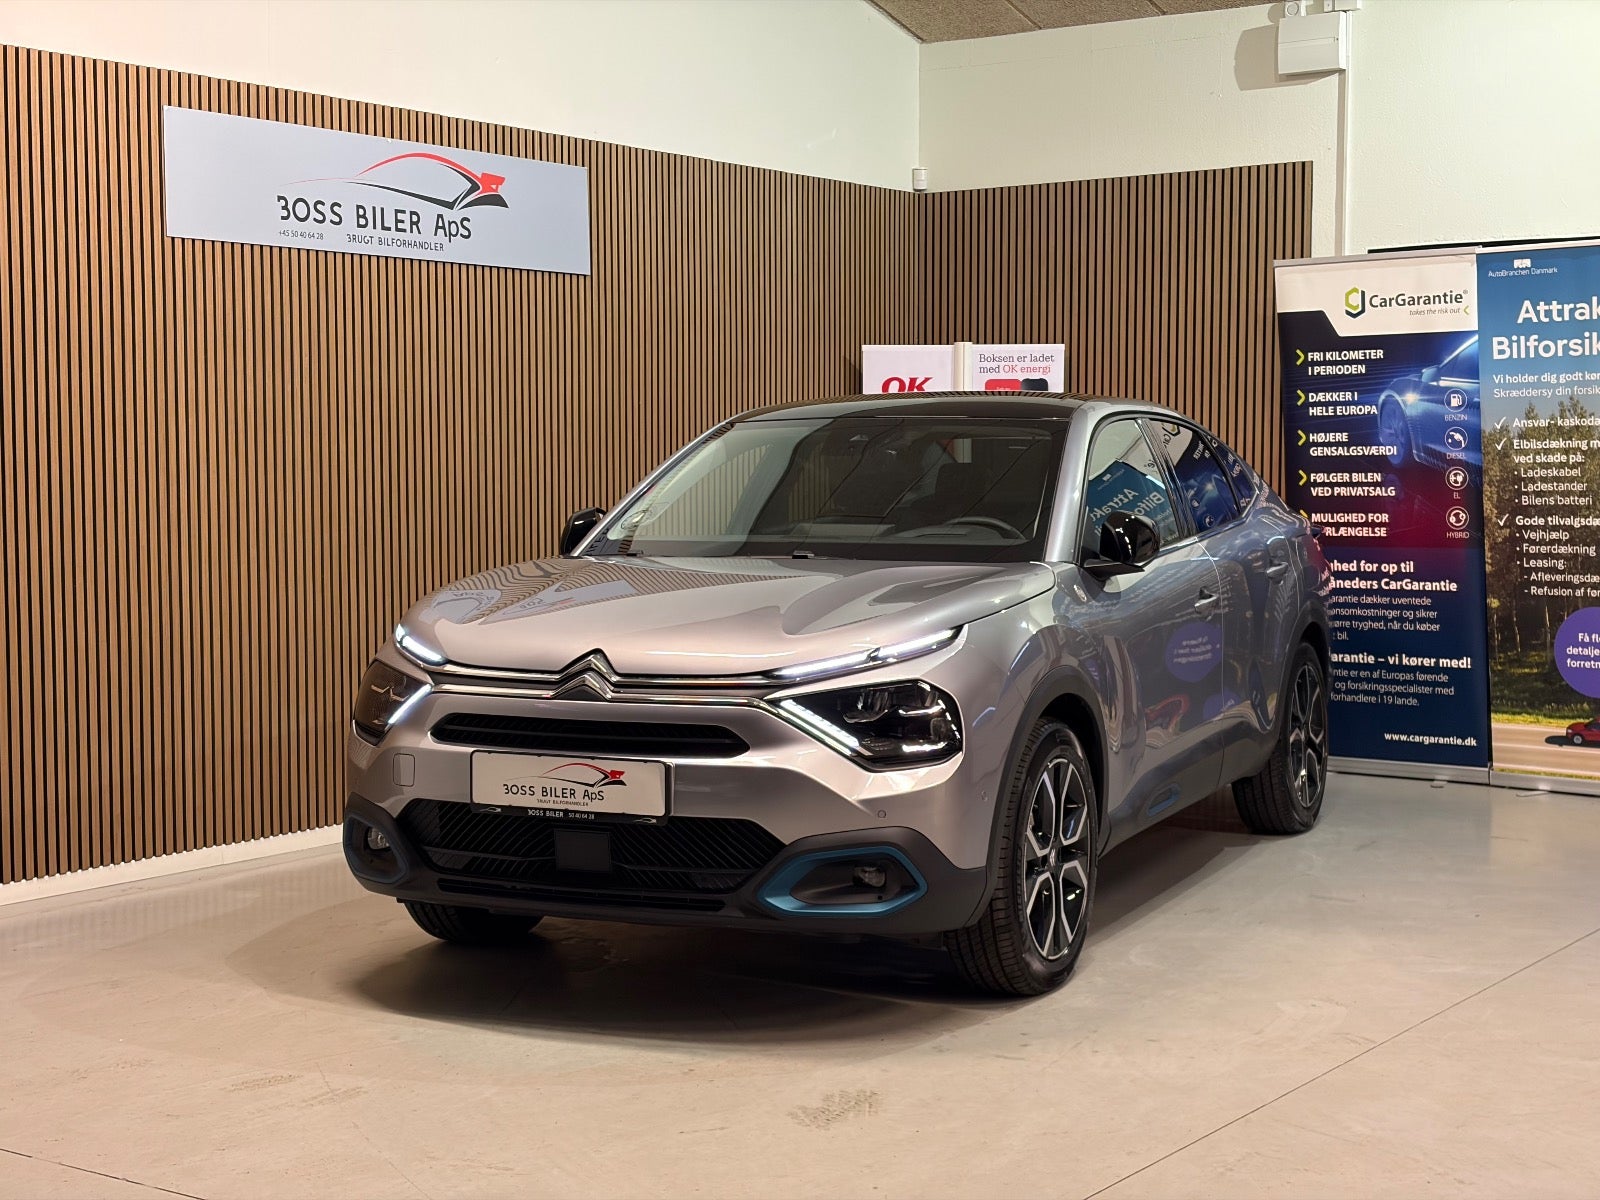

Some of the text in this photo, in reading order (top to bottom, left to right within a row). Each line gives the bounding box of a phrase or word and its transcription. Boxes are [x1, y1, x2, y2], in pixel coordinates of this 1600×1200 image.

[356, 204, 422, 234] BILER
[434, 213, 472, 243] ApS
[279, 229, 324, 240] +45 50 40 64 28
[378, 237, 444, 252] BILFORHANDLER
[1488, 266, 1558, 278] AutoBranchen Danmark
[1409, 308, 1425, 316] takes
[1426, 307, 1436, 315] the
[1437, 307, 1449, 315] risk
[979, 353, 1055, 363] Boksen er ladet
[1308, 349, 1384, 362] FRI KILOMETER
[979, 365, 1051, 376] med OK energi
[1308, 364, 1366, 375] I PERIODEN
[1493, 374, 1504, 384] Vi
[1505, 374, 1539, 384] holder
[1541, 372, 1557, 383] dig
[1559, 371, 1583, 384] godt
[882, 376, 933, 393] OK
[1309, 392, 1358, 402] DÆKKER I
[1494, 387, 1553, 399] Skræddersy
[1555, 386, 1571, 396] din
[1309, 405, 1378, 416] HELE EUROPA
[1444, 414, 1468, 422] BENZIN
[1512, 417, 1555, 428] Ansvar-
[1309, 432, 1349, 443] HØJERE
[1513, 439, 1588, 451] Elbilsdækning
[1310, 445, 1397, 457] GENSALGSVÆRDI
[1513, 453, 1585, 465] ved skade på:
[1310, 472, 1381, 484] FØLGER BILEN
[1521, 467, 1582, 478] Ladeskabel
[1311, 486, 1396, 497] VED PRIVATSALG
[1521, 481, 1588, 491] Ladestander
[1521, 495, 1593, 505] Bilens batteri
[1311, 512, 1389, 523] MULIGHED FOR
[1515, 515, 1545, 526] Gode
[1446, 531, 1470, 539] HYBRID
[1522, 529, 1570, 541] Vejhjælp
[1523, 544, 1597, 557] Førerdækning
[1359, 560, 1379, 573] for
[1381, 562, 1398, 575] op
[1400, 561, 1414, 573] til
[1523, 557, 1567, 570] Leasing:
[1381, 578, 1458, 592] CarGarantie
[1530, 586, 1572, 597] Refusion
[1574, 587, 1585, 597] af
[1360, 594, 1390, 604] dækker
[1392, 596, 1432, 606] uventede
[1402, 610, 1414, 620] og
[1415, 609, 1438, 619] sikrer
[1352, 620, 1386, 632] tryghed,
[1387, 622, 1402, 630] når
[1402, 623, 1415, 631] du
[1416, 623, 1441, 632] køber
[1337, 631, 1349, 641] bil.
[1578, 632, 1589, 643] Få
[1330, 652, 1375, 664] arantie
[1387, 653, 1399, 665] vi
[1402, 654, 1437, 668] kører
[1439, 656, 1472, 669] med!
[1349, 670, 1359, 678] er
[1359, 671, 1371, 679] en
[1372, 670, 1381, 679] af
[1381, 670, 1415, 682] Europas
[1416, 672, 1449, 683] førende
[1334, 680, 1455, 695] og forsikringsspecialister med
[1378, 695, 1381, 704] i
[1383, 695, 1393, 704] 19
[1394, 695, 1420, 706] lande.
[1384, 732, 1478, 747] www.cargarantie.dk
[541, 786, 576, 799] BILER
[582, 789, 605, 803] ApS
[545, 810, 564, 818] BILER
